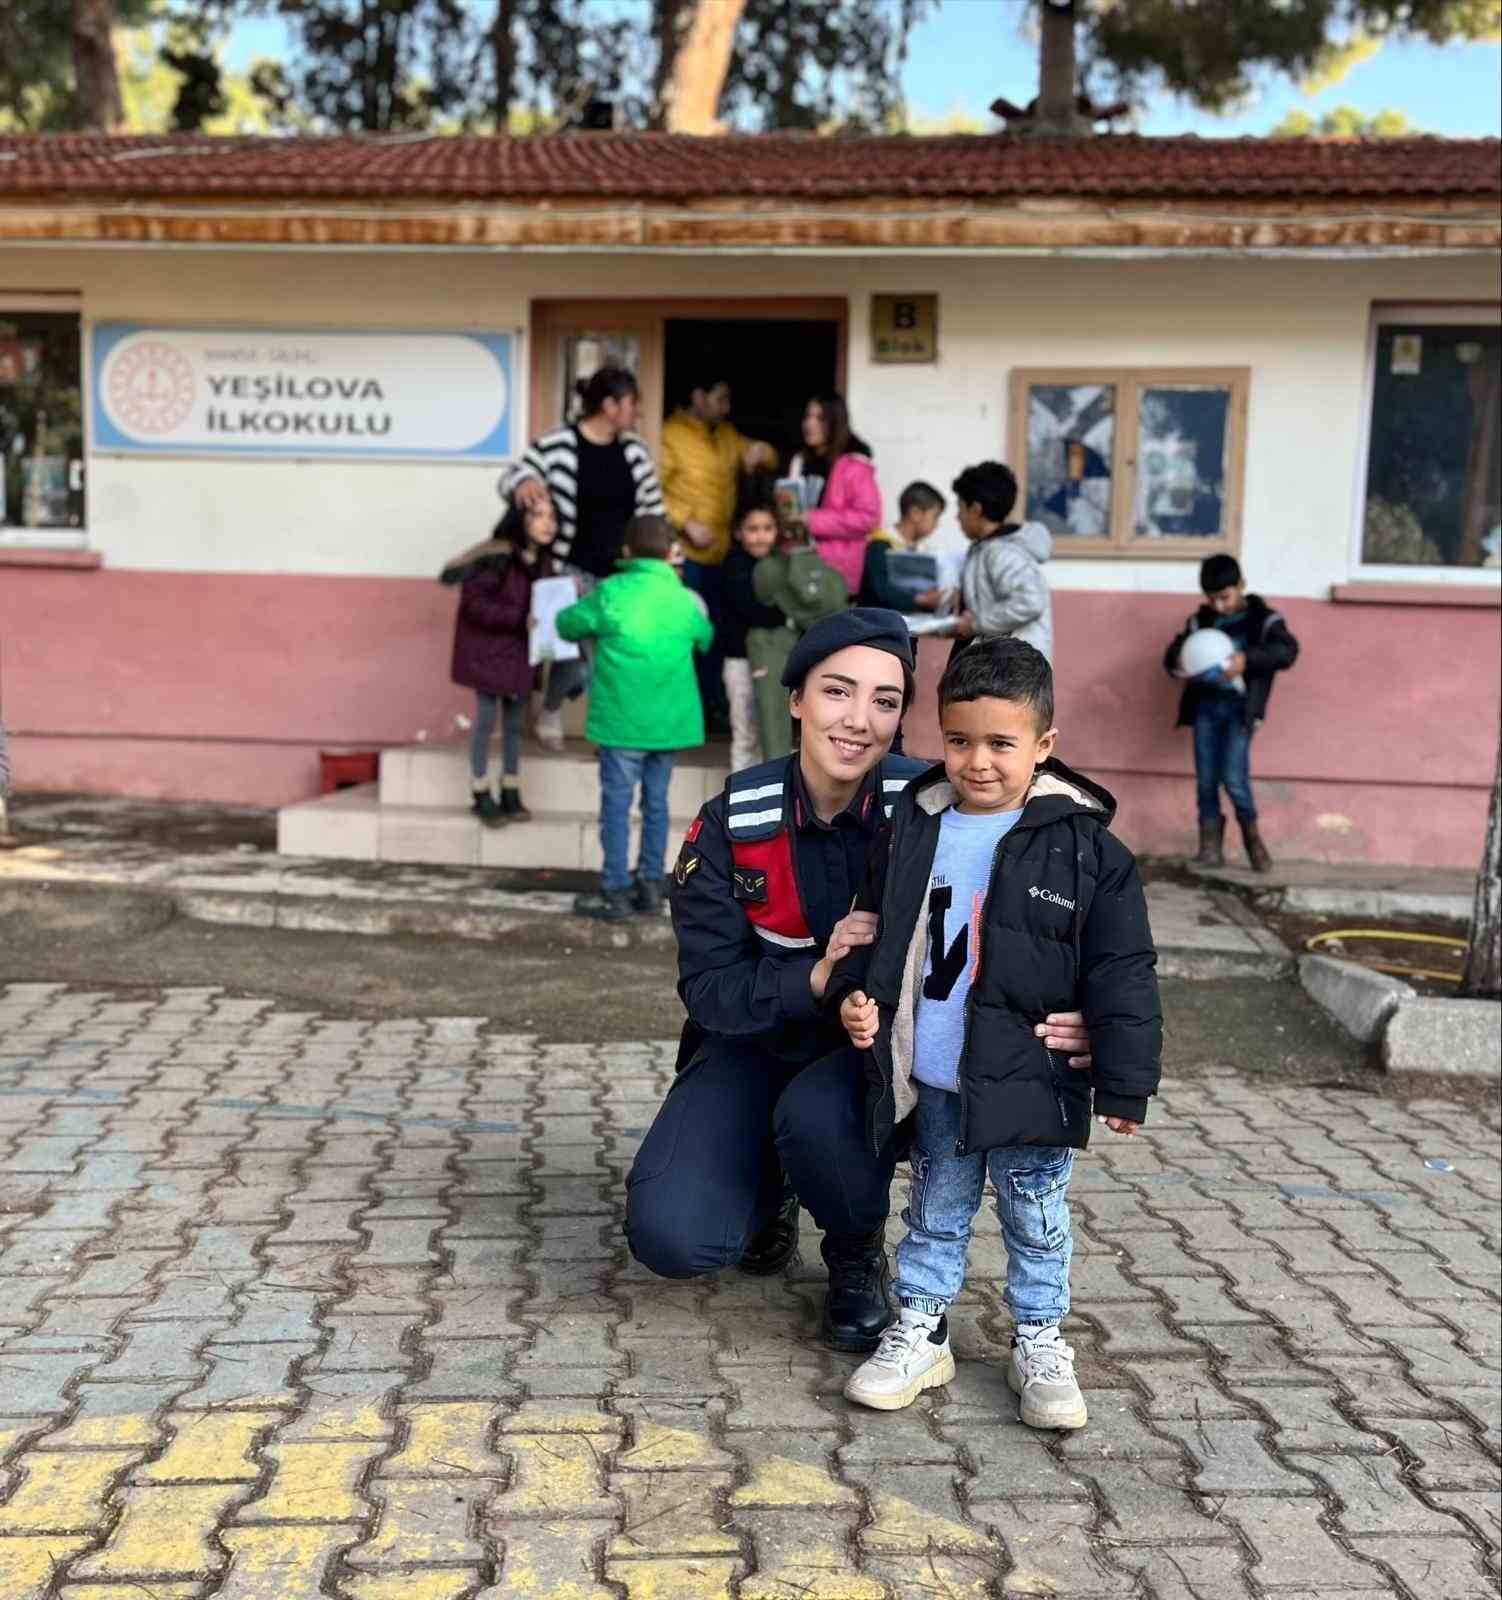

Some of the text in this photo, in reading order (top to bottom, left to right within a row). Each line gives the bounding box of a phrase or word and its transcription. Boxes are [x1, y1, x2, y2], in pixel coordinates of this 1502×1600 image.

[895, 303, 916, 329] B
[206, 373, 384, 403] YEŞİLOVA
[207, 406, 391, 434] İLKOKULU
